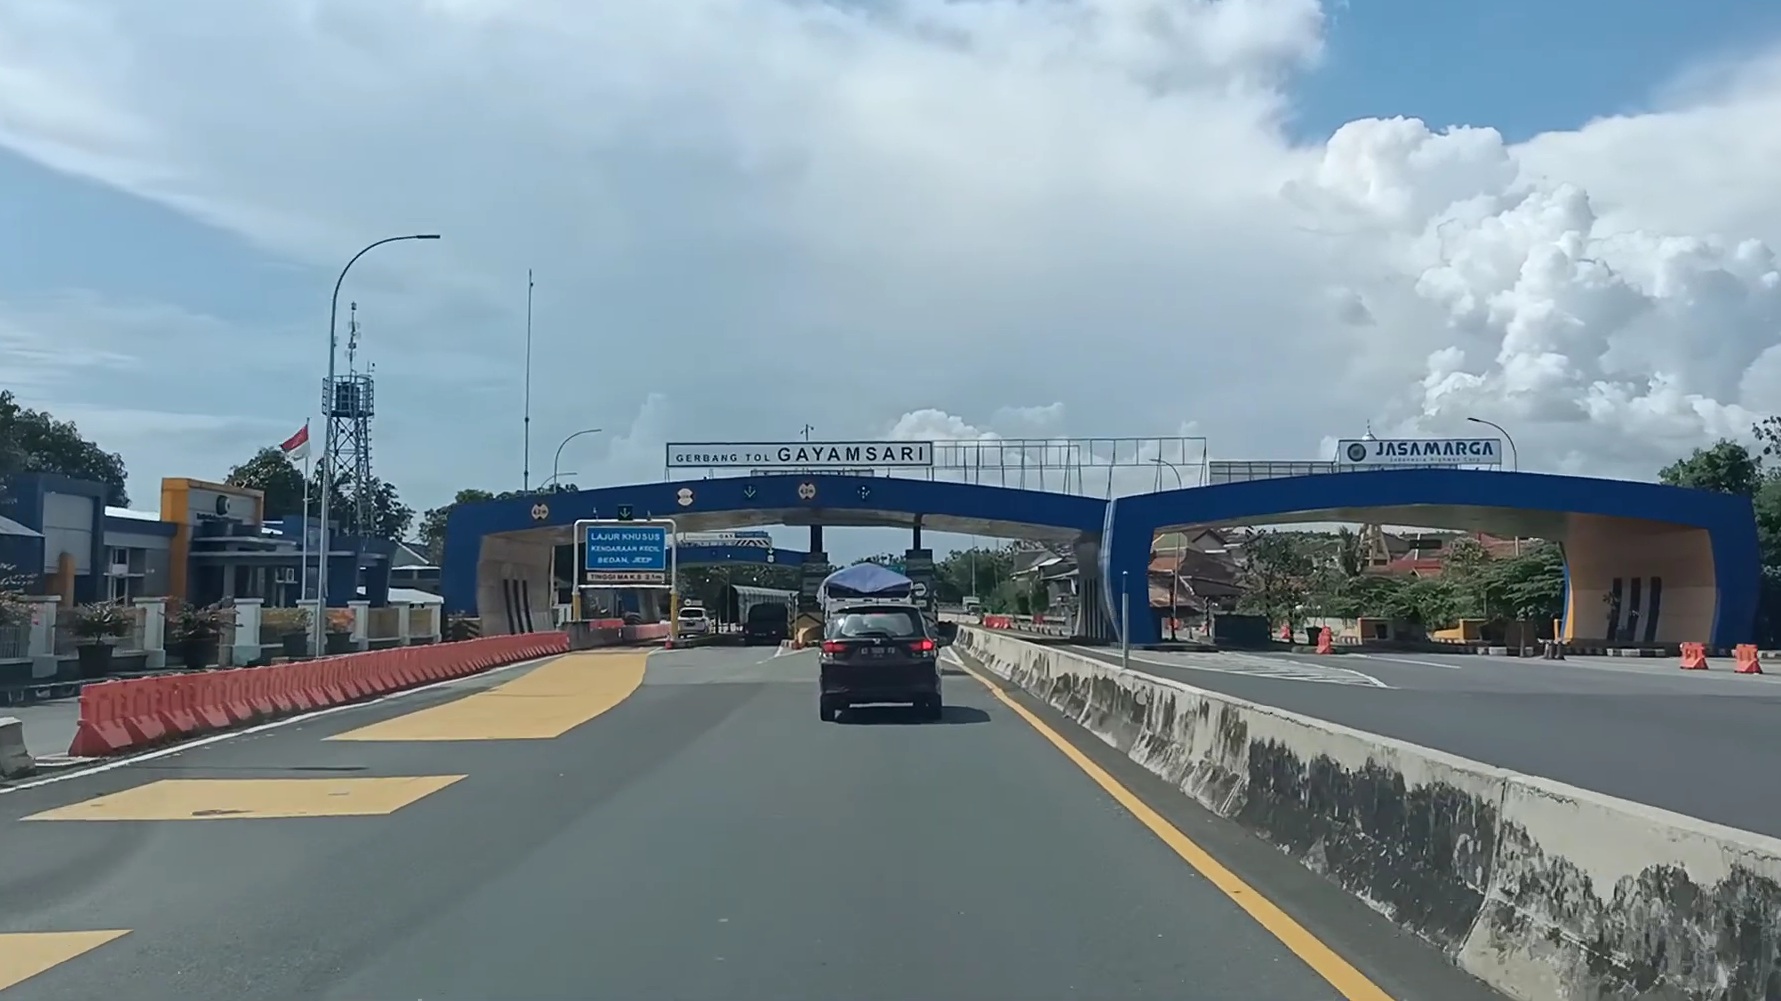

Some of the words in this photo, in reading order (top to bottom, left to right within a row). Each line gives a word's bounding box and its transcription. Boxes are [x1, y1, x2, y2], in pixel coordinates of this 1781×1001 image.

[676, 454, 737, 463] GERBANG
[746, 454, 770, 462] TOL
[778, 447, 923, 462] GAYAMSARI
[1376, 442, 1493, 456] JASAMARGA
